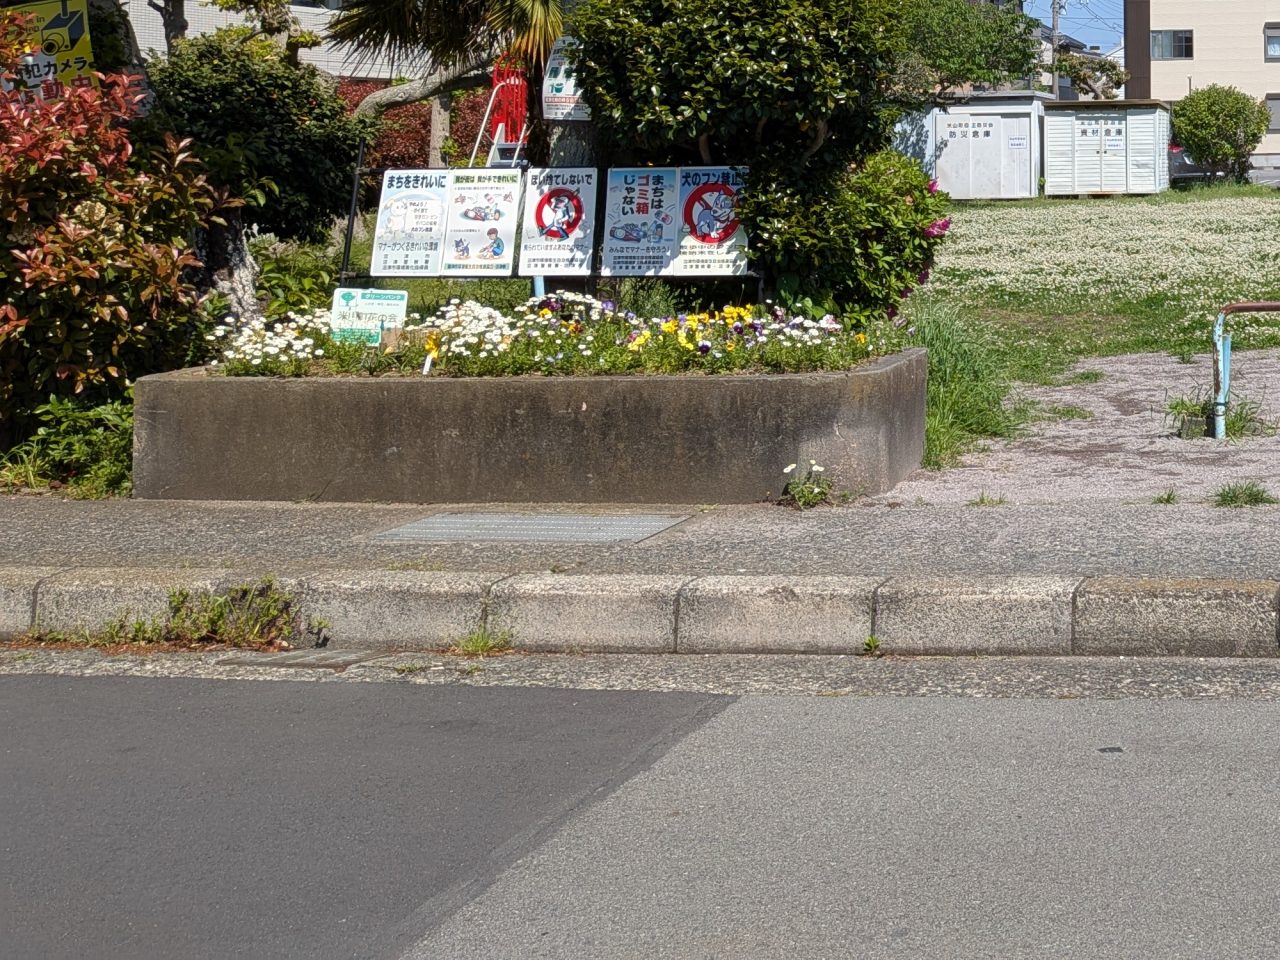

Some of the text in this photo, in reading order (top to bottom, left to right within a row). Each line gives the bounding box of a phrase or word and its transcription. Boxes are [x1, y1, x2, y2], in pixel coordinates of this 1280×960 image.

[15, 56, 87, 81] 犯カメラ
[387, 175, 447, 189] まちをきれいに
[621, 174, 636, 216] じゃない
[635, 174, 650, 215] ゴミ箱
[651, 174, 664, 209] まちは
